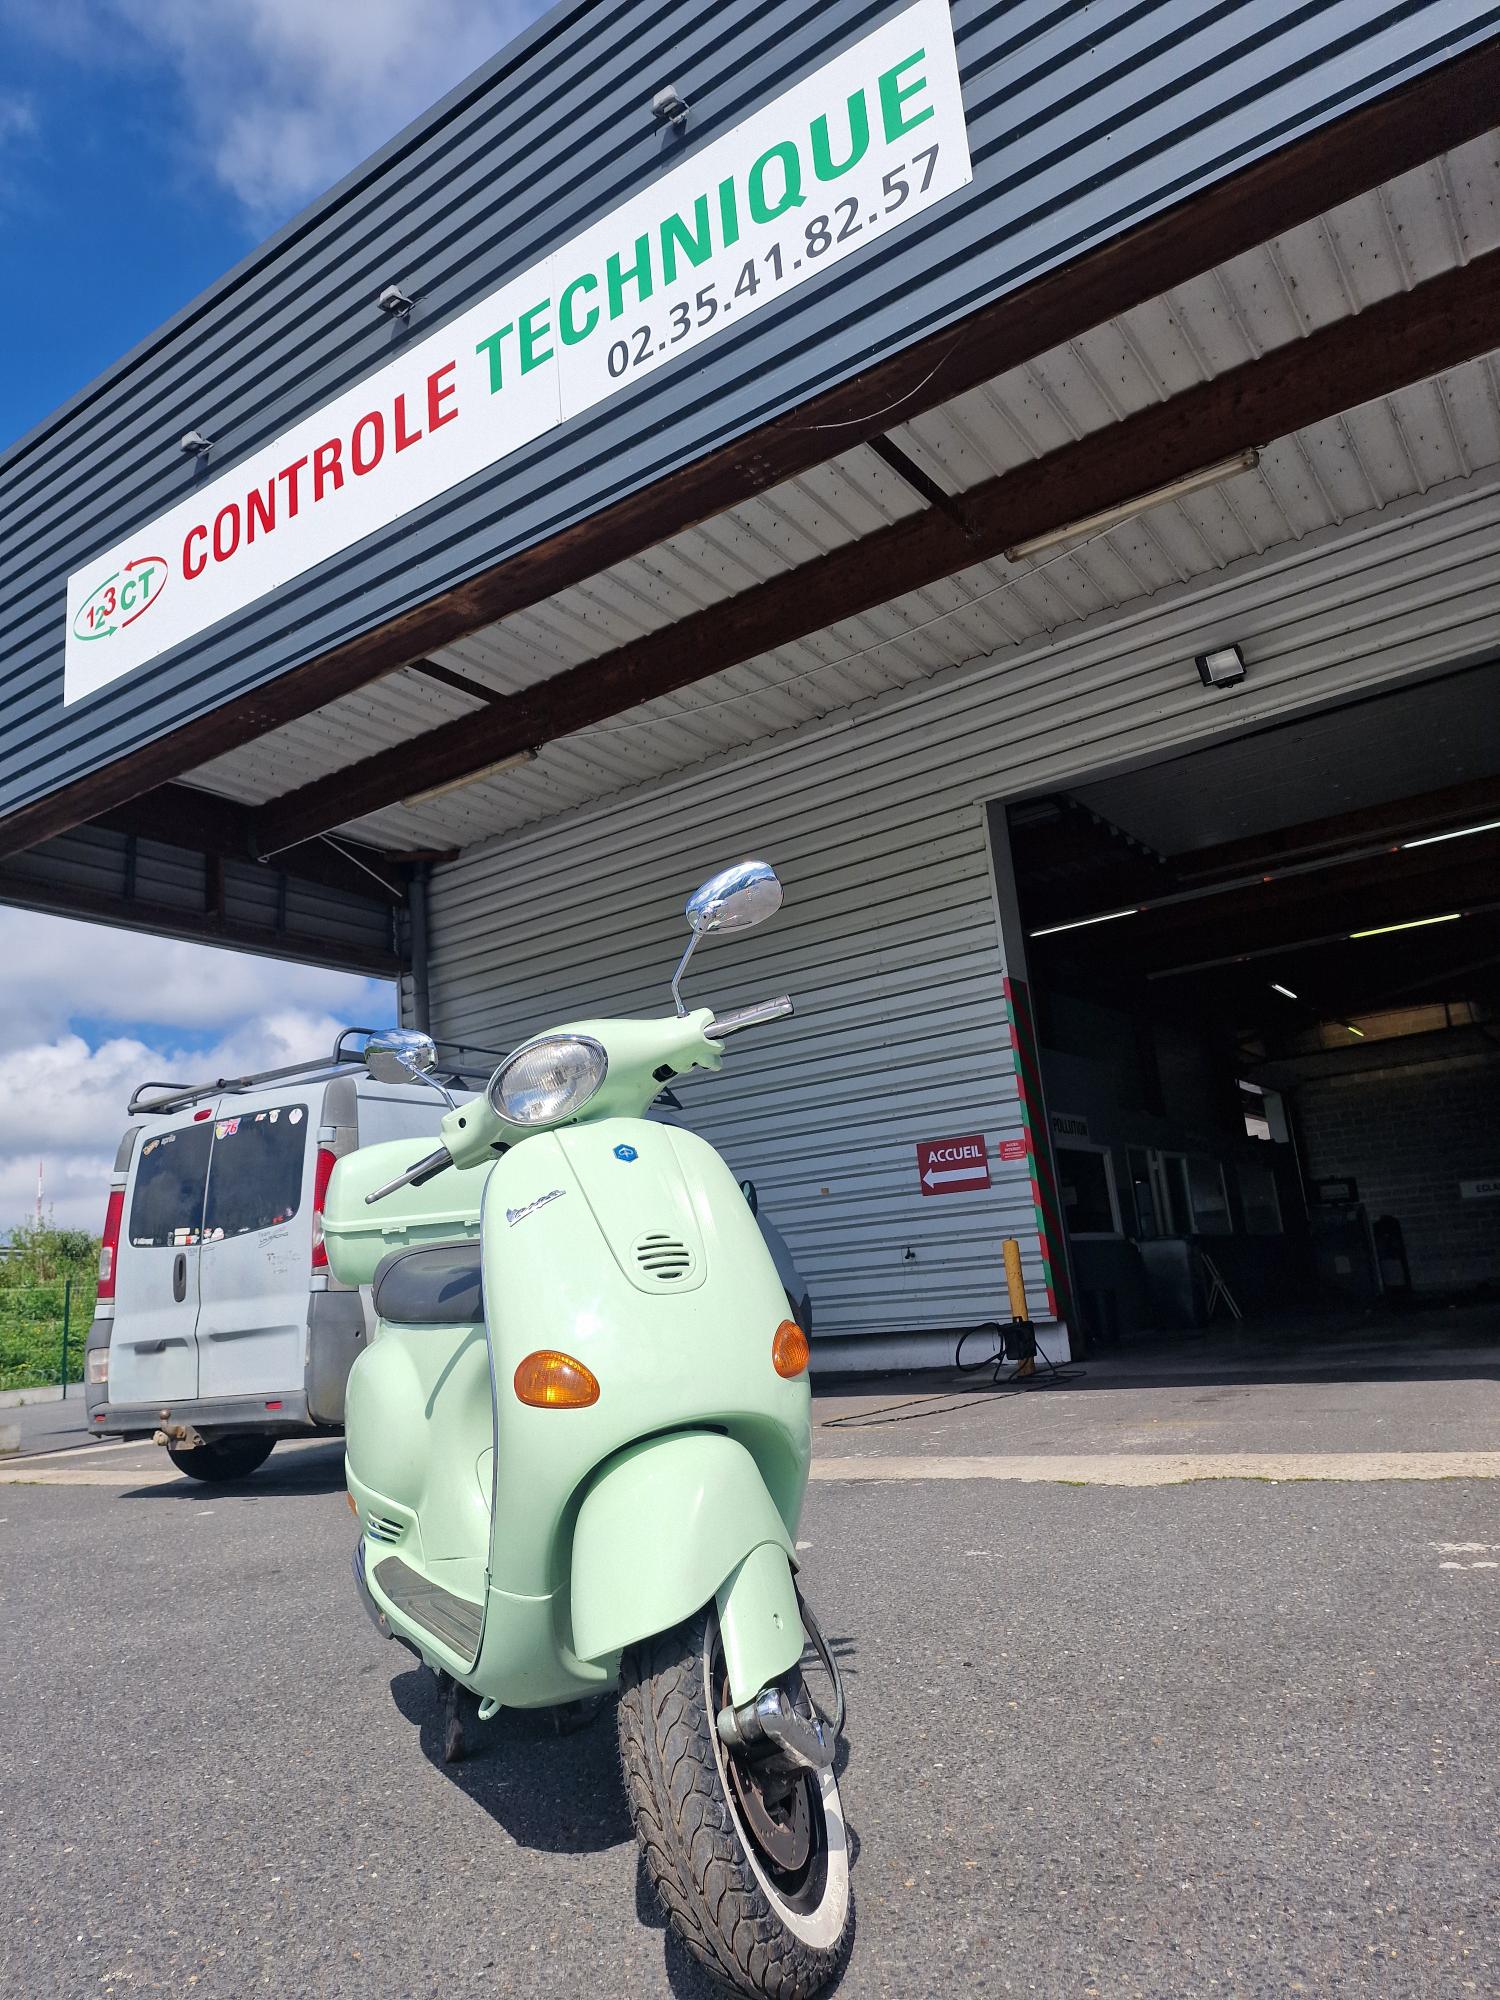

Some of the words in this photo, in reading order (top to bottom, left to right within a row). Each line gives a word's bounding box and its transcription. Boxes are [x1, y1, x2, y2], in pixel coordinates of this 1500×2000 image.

[181, 359, 459, 581] CONTROLE
[476, 47, 935, 395] TECHNIQUE
[607, 145, 940, 378] 02.35.41.82.57
[928, 1145, 983, 1164] ACCUEIL
[1052, 1117, 1088, 1136] POLLUTION
